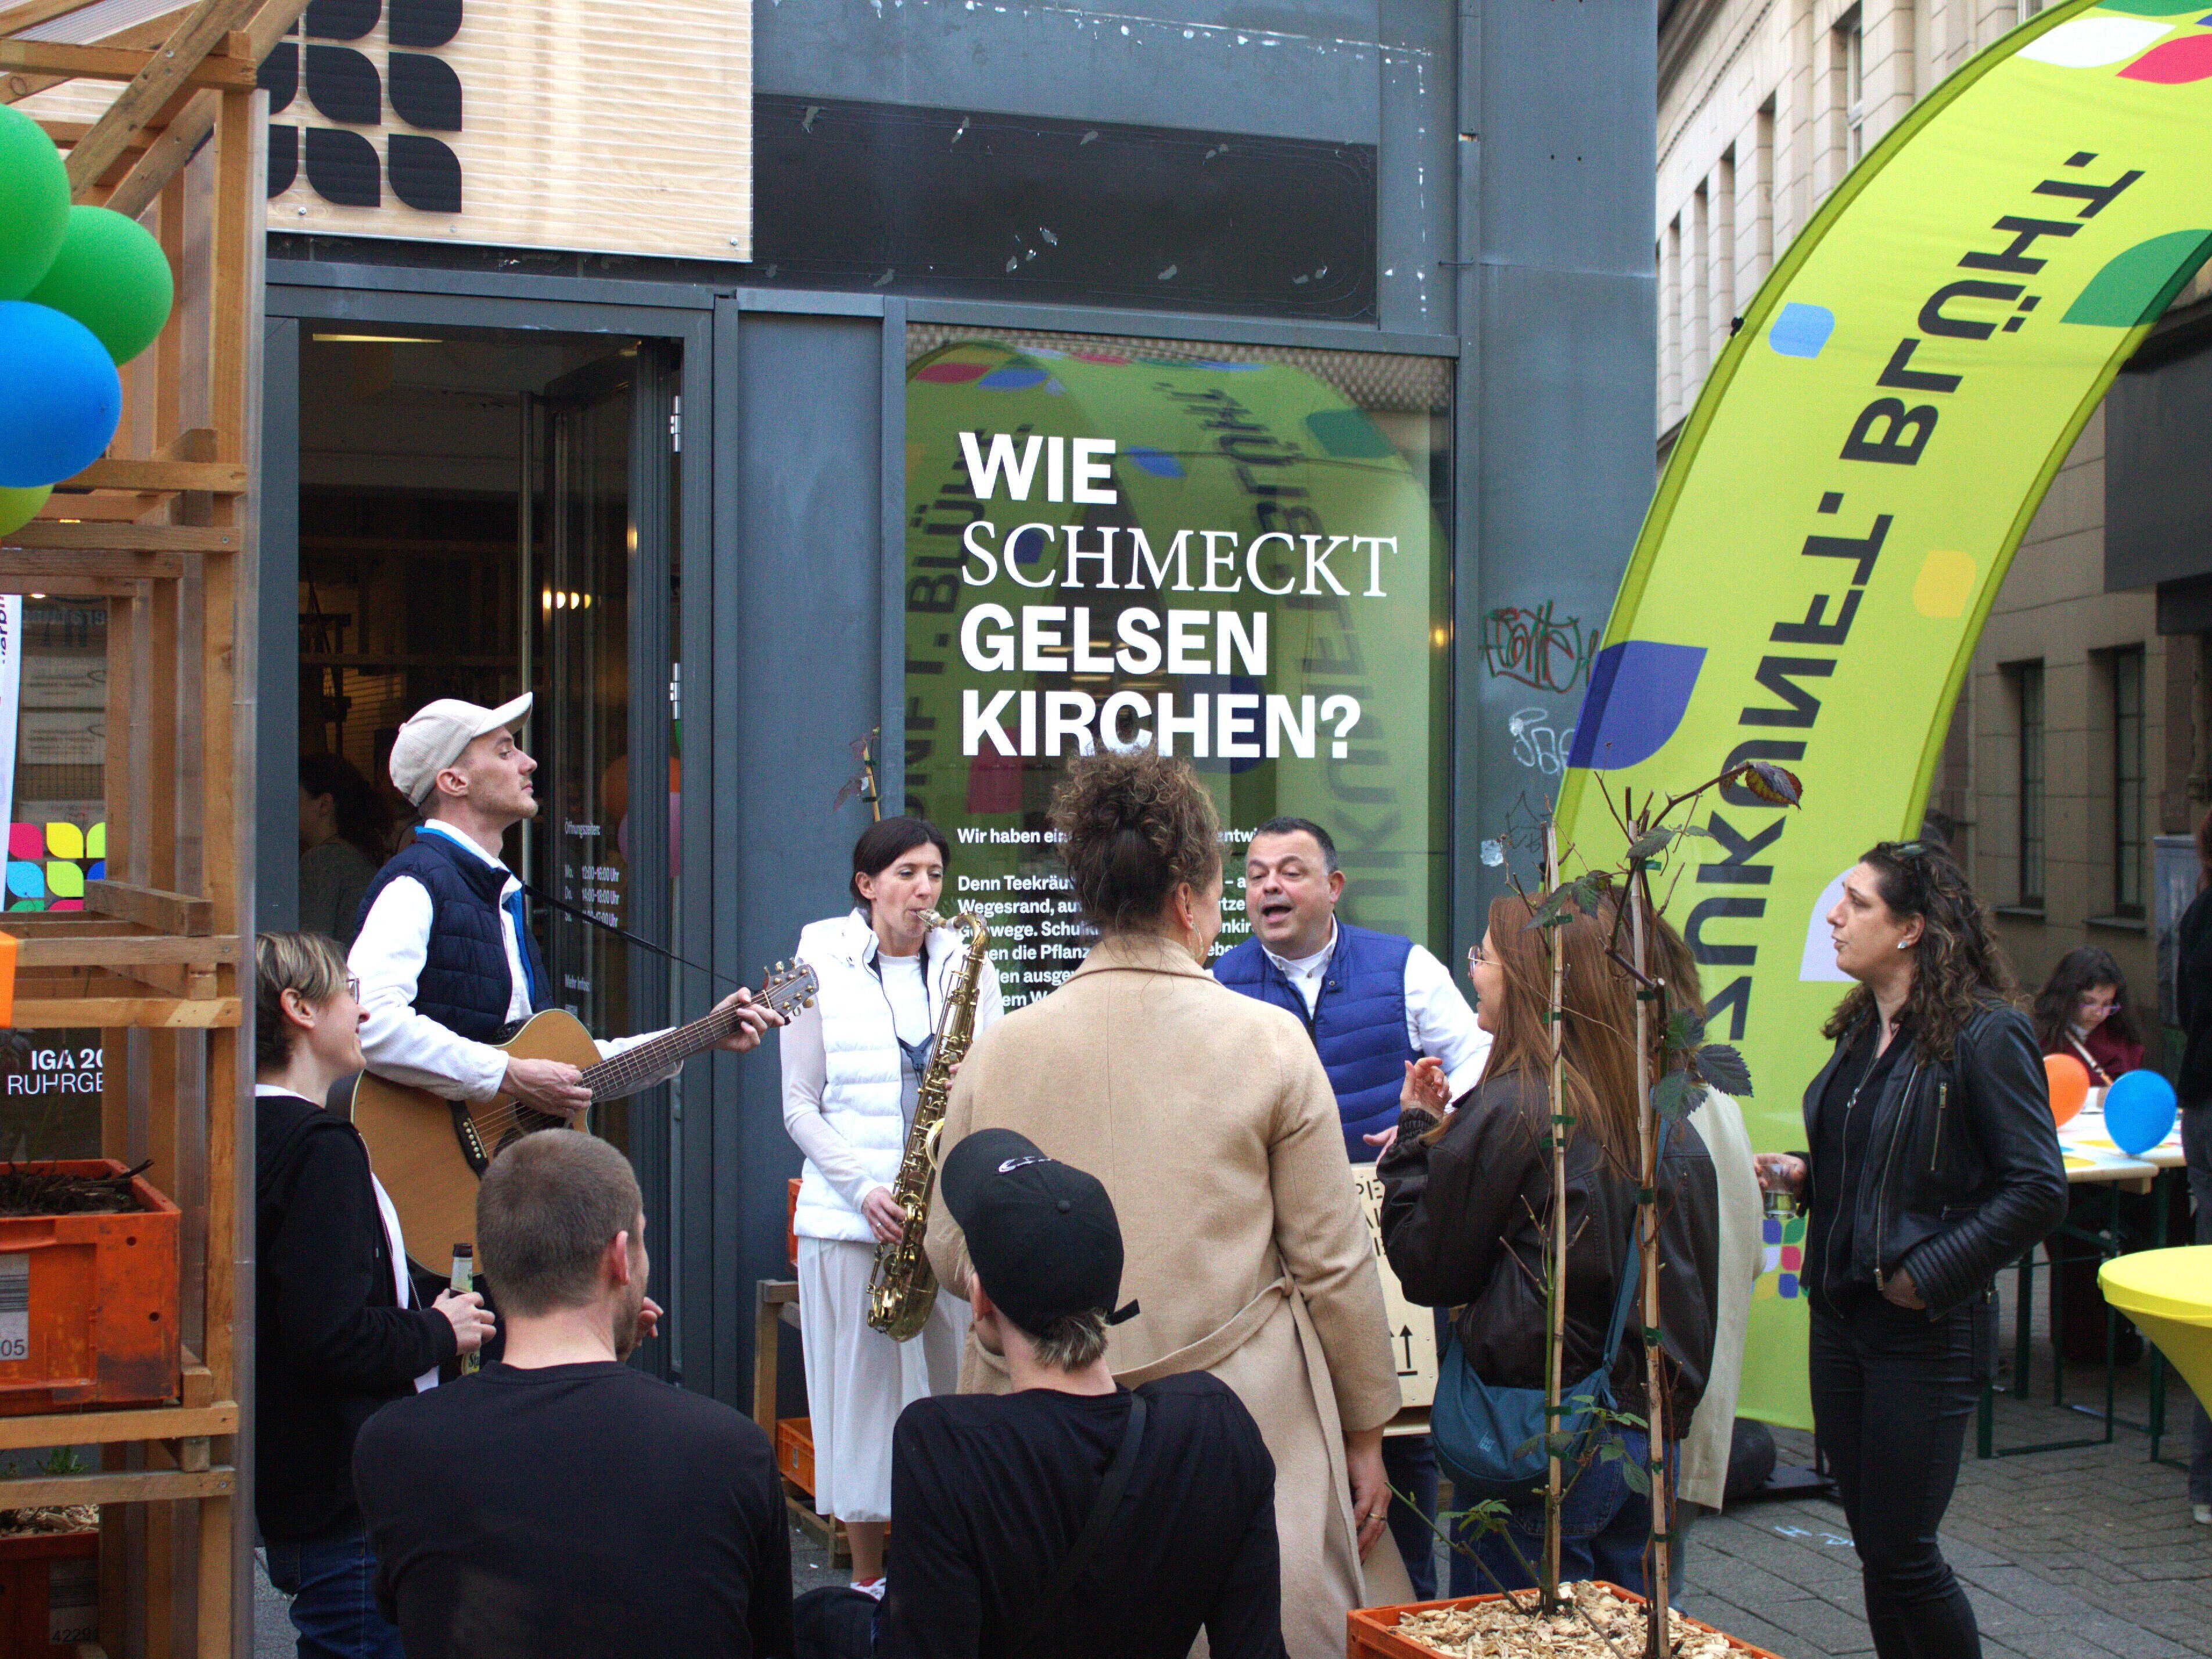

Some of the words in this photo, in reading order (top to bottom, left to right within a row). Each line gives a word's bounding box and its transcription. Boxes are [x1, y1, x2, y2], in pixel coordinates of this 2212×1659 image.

[958, 432, 1118, 505] WIE
[961, 521, 1398, 597] SCHMECKT
[960, 603, 1268, 676] GELSEN
[962, 690, 1361, 759] KIRCHEN?
[957, 828, 987, 843] Wir
[990, 827, 1040, 843] haben
[958, 876, 1000, 891] Denn
[957, 899, 1055, 918] Wegesrand,
[1012, 945, 1037, 960] die
[31, 1049, 76, 1071] IGA
